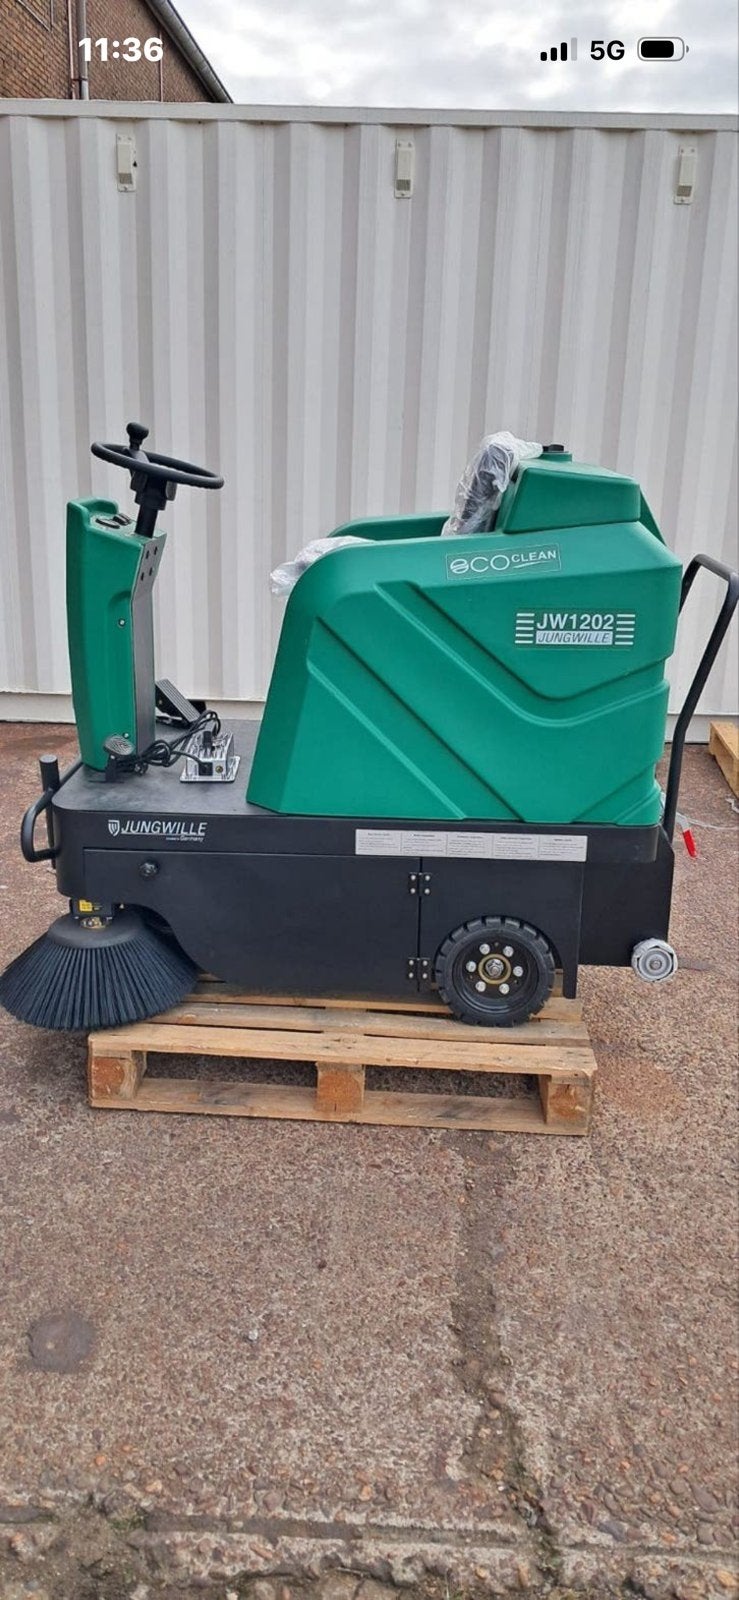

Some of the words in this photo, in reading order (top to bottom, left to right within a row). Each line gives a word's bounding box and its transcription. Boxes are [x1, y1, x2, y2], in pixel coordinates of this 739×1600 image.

[511, 549, 557, 563] CLEAN
[536, 613, 614, 630] JW1202
[537, 631, 611, 644] JUNGWILLE
[121, 820, 208, 836] JUNGWILLE
